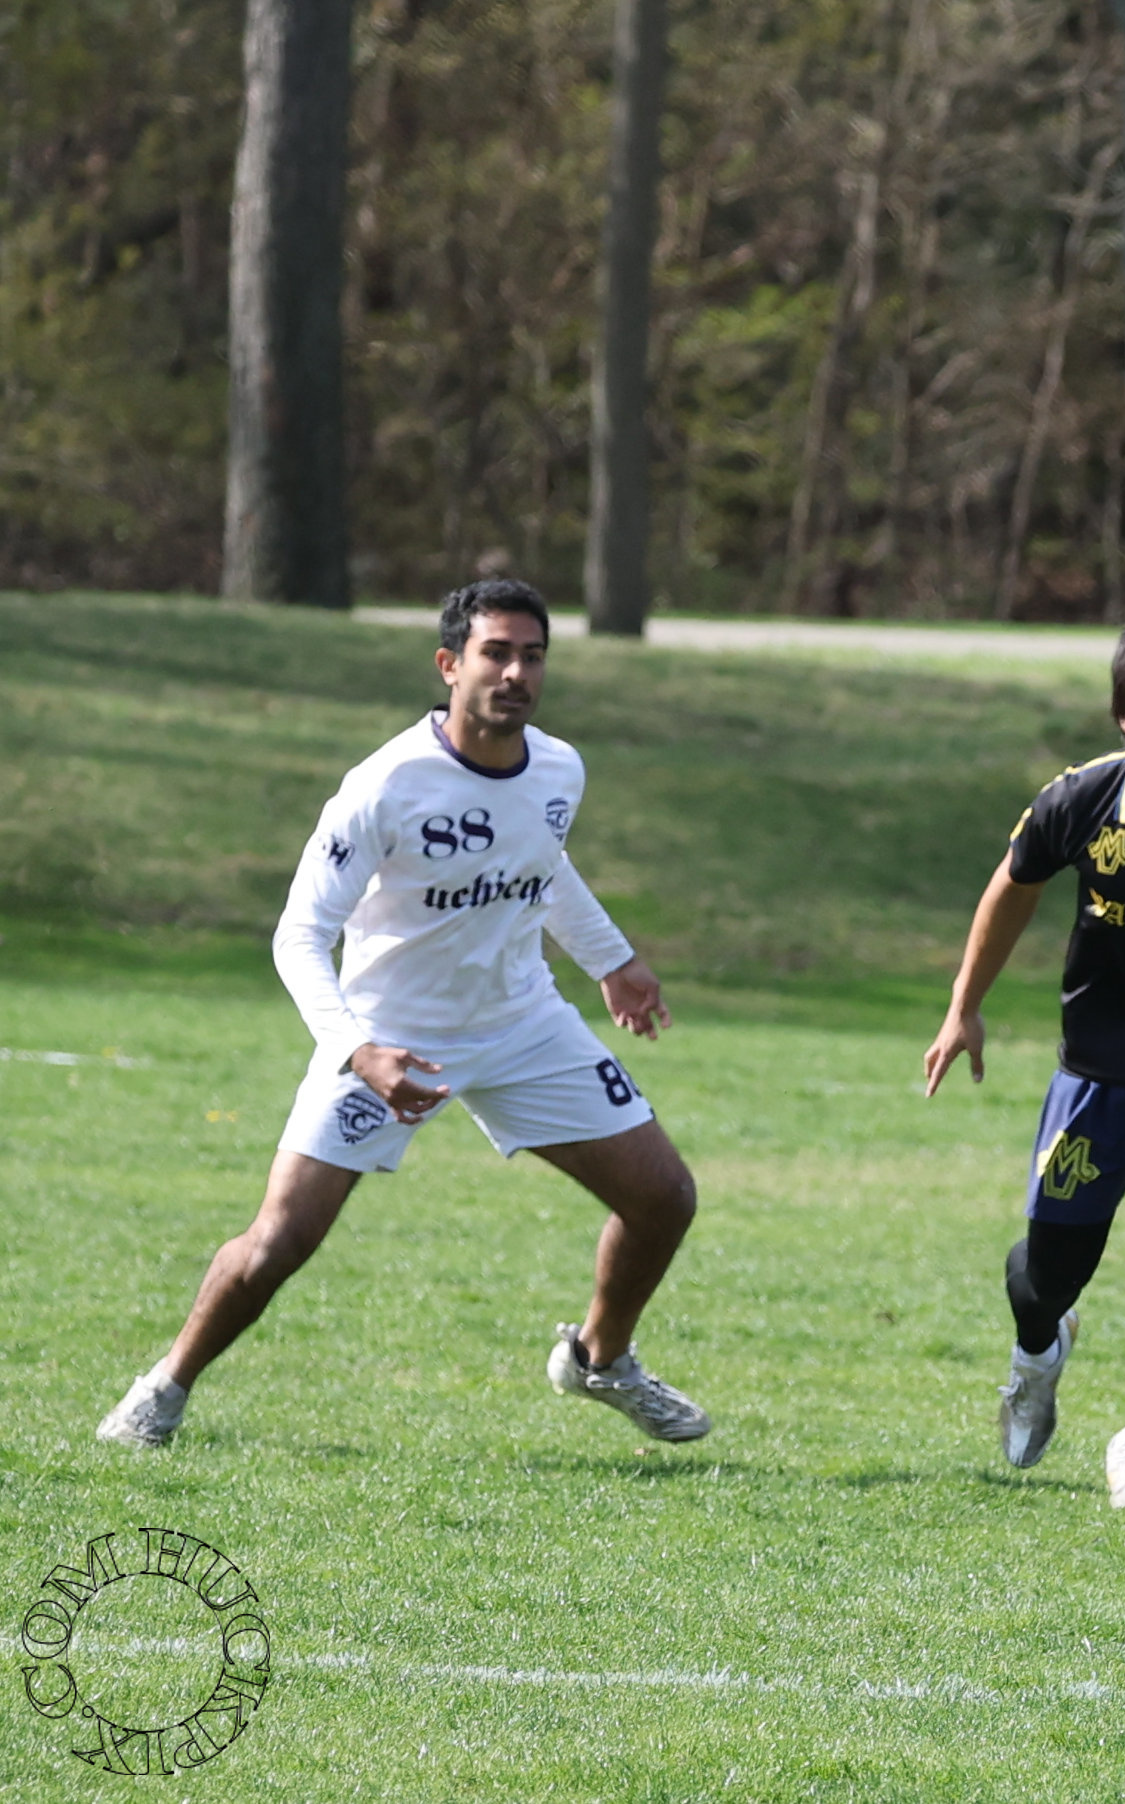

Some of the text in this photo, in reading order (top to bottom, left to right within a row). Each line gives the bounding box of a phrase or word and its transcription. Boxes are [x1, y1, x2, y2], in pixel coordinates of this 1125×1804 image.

[421, 807, 495, 859] 88
[424, 869, 556, 910] uchica
[596, 1058, 643, 1107] 8
